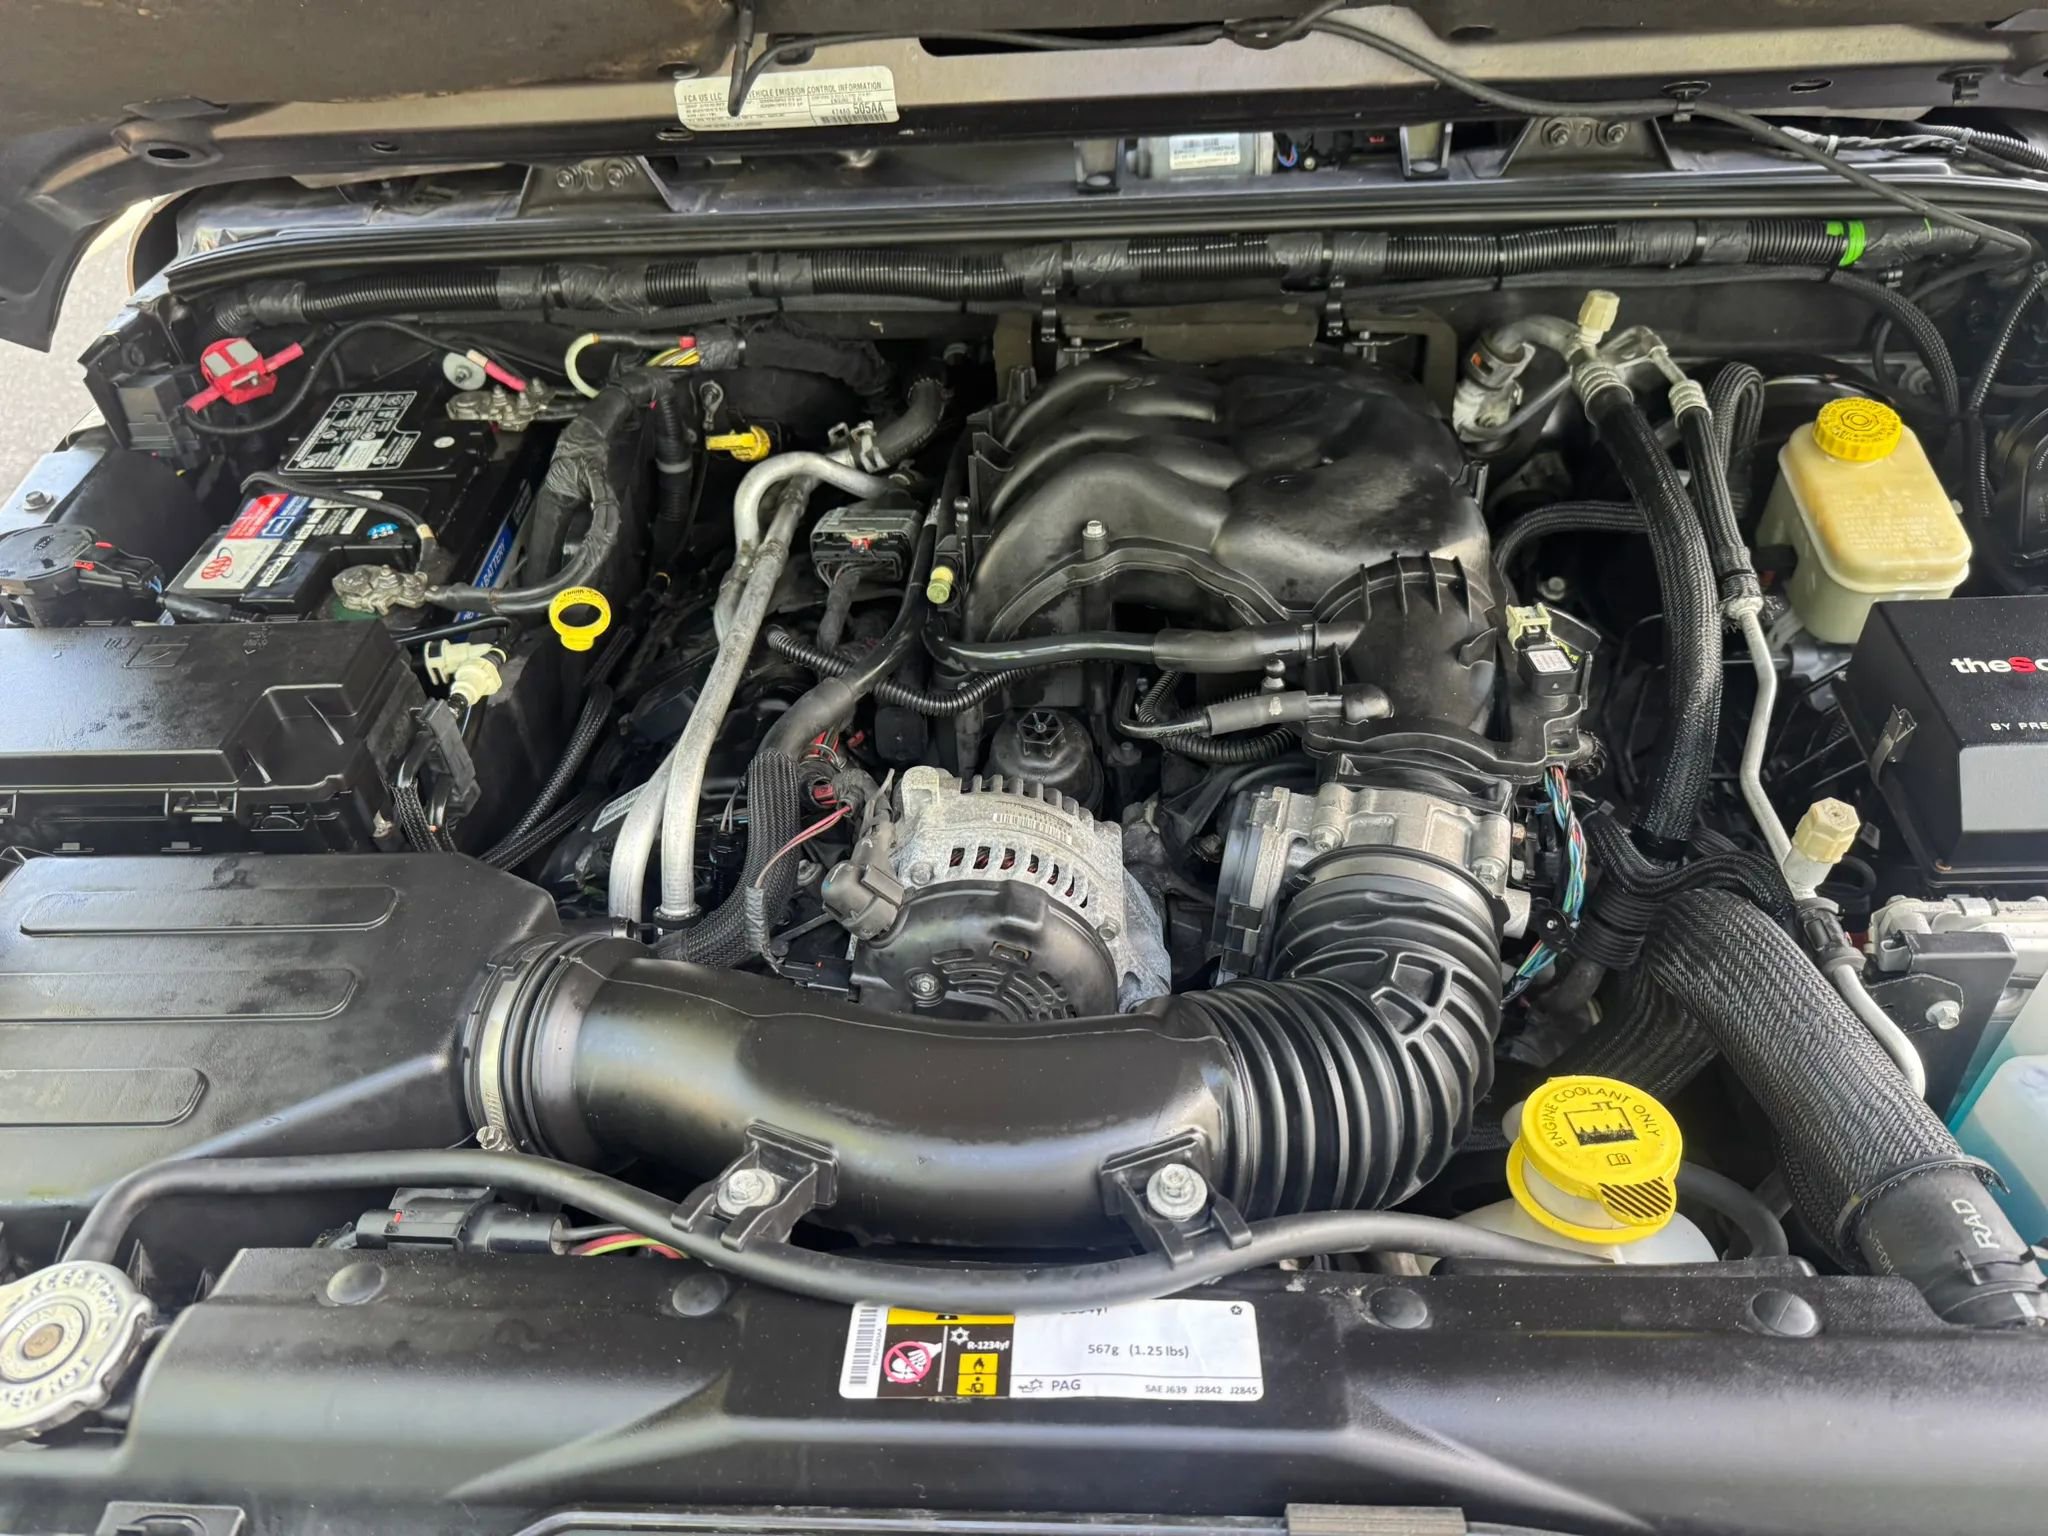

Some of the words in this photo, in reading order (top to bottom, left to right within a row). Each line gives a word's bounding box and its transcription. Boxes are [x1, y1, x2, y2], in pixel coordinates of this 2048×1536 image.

[684, 93, 698, 102] FCA
[699, 93, 710, 101] US
[711, 92, 723, 101] LLC
[774, 87, 806, 97] EMISSION
[807, 84, 836, 94] CONTROL
[838, 81, 882, 92] INFORMATION
[853, 102, 885, 114] 505AA
[483, 538, 506, 588] BATTERY
[1990, 722, 2011, 731] BY
[1554, 1086, 1632, 1104] COOLANT
[1542, 1103, 1567, 1148] ENGINE
[1634, 1104, 1661, 1138] ONLY
[1952, 1198, 2001, 1250] RAD
[966, 1340, 1010, 1351] R-1234yf
[1087, 1343, 1120, 1357] 567g
[1129, 1343, 1163, 1358] (1.25
[1165, 1344, 1190, 1359] lbs)
[1051, 1379, 1082, 1391] PAG
[1145, 1384, 1163, 1393] SAE
[1164, 1385, 1188, 1394] J639
[1194, 1385, 1223, 1395] J2842
[1229, 1386, 1258, 1395] J2845
